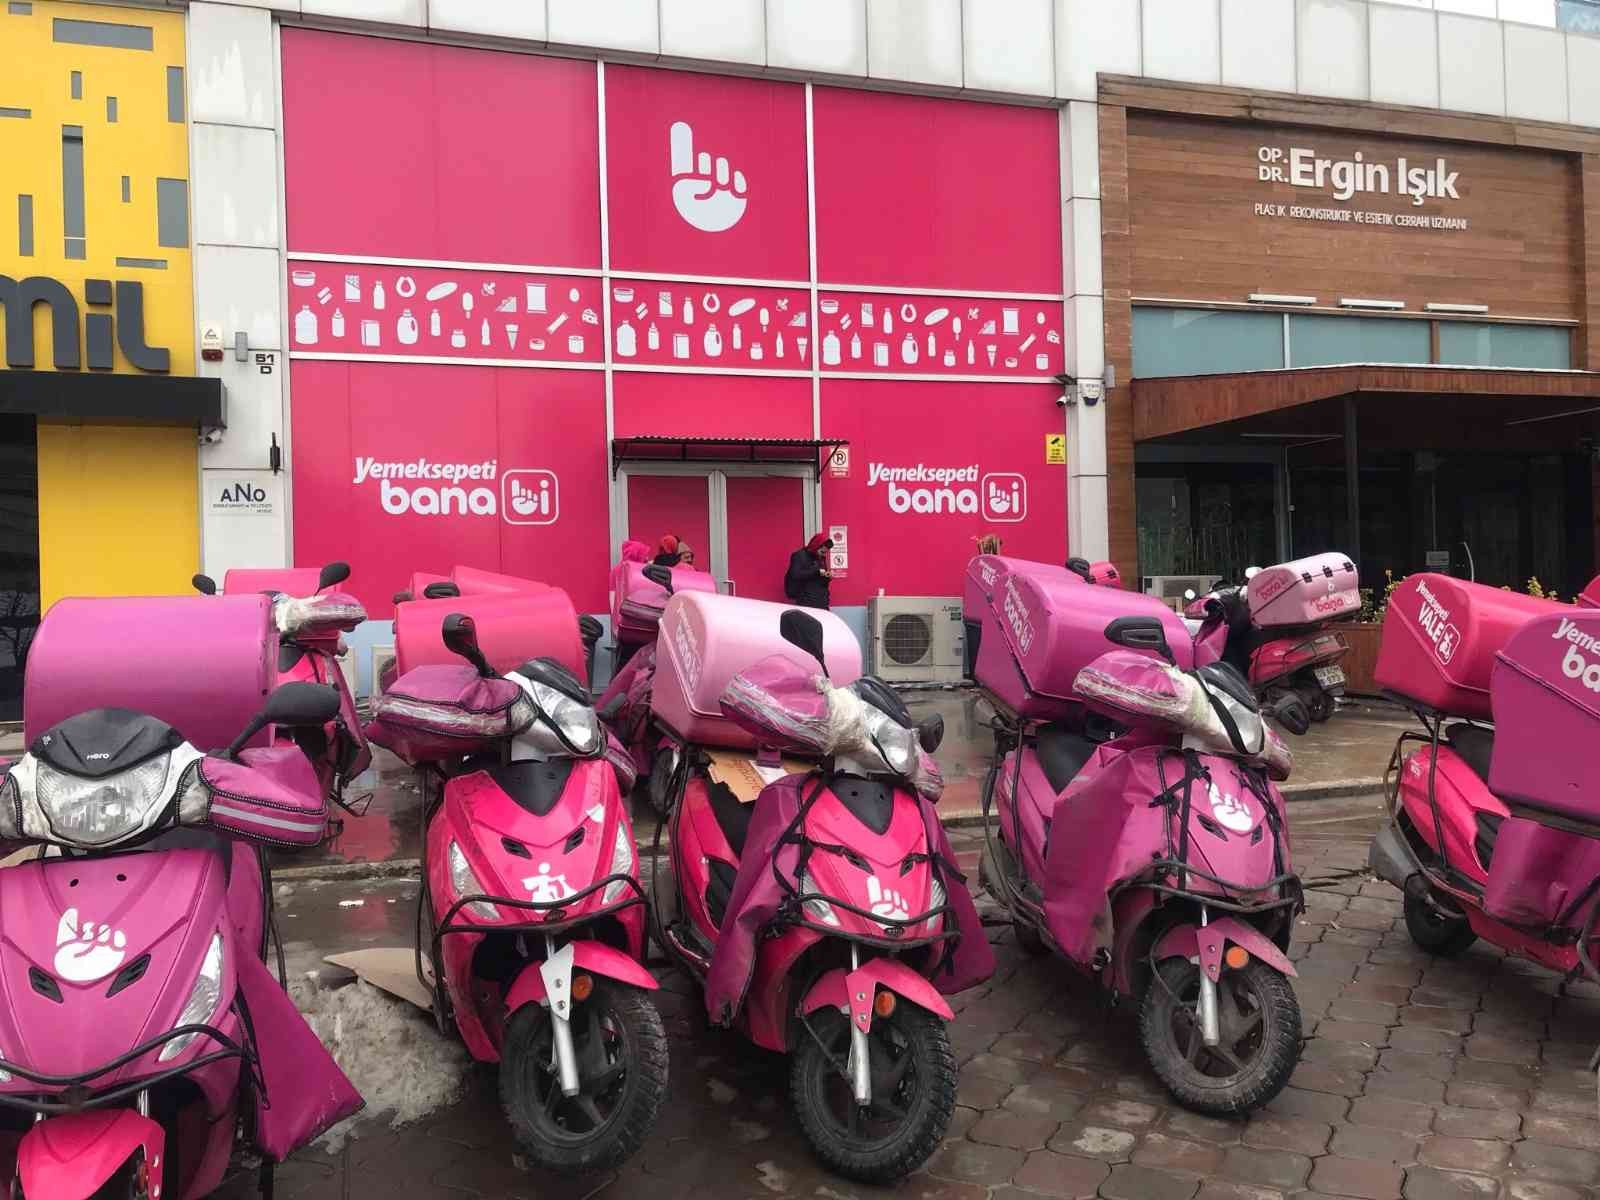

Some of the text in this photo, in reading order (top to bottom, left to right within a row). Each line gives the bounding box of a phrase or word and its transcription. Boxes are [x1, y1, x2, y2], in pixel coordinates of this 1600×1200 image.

[1258, 147, 1288, 163] OP.
[1259, 166, 1289, 183] DR.
[1290, 148, 1460, 206] Ergin Işık
[1353, 211, 1364, 223] VE
[256, 353, 274, 363] 51
[353, 457, 497, 484] Yemeksepeti
[867, 463, 979, 486] Yemeksepeti
[381, 479, 497, 515] bana
[888, 482, 978, 513] bana
[1418, 601, 1445, 643] VALE
